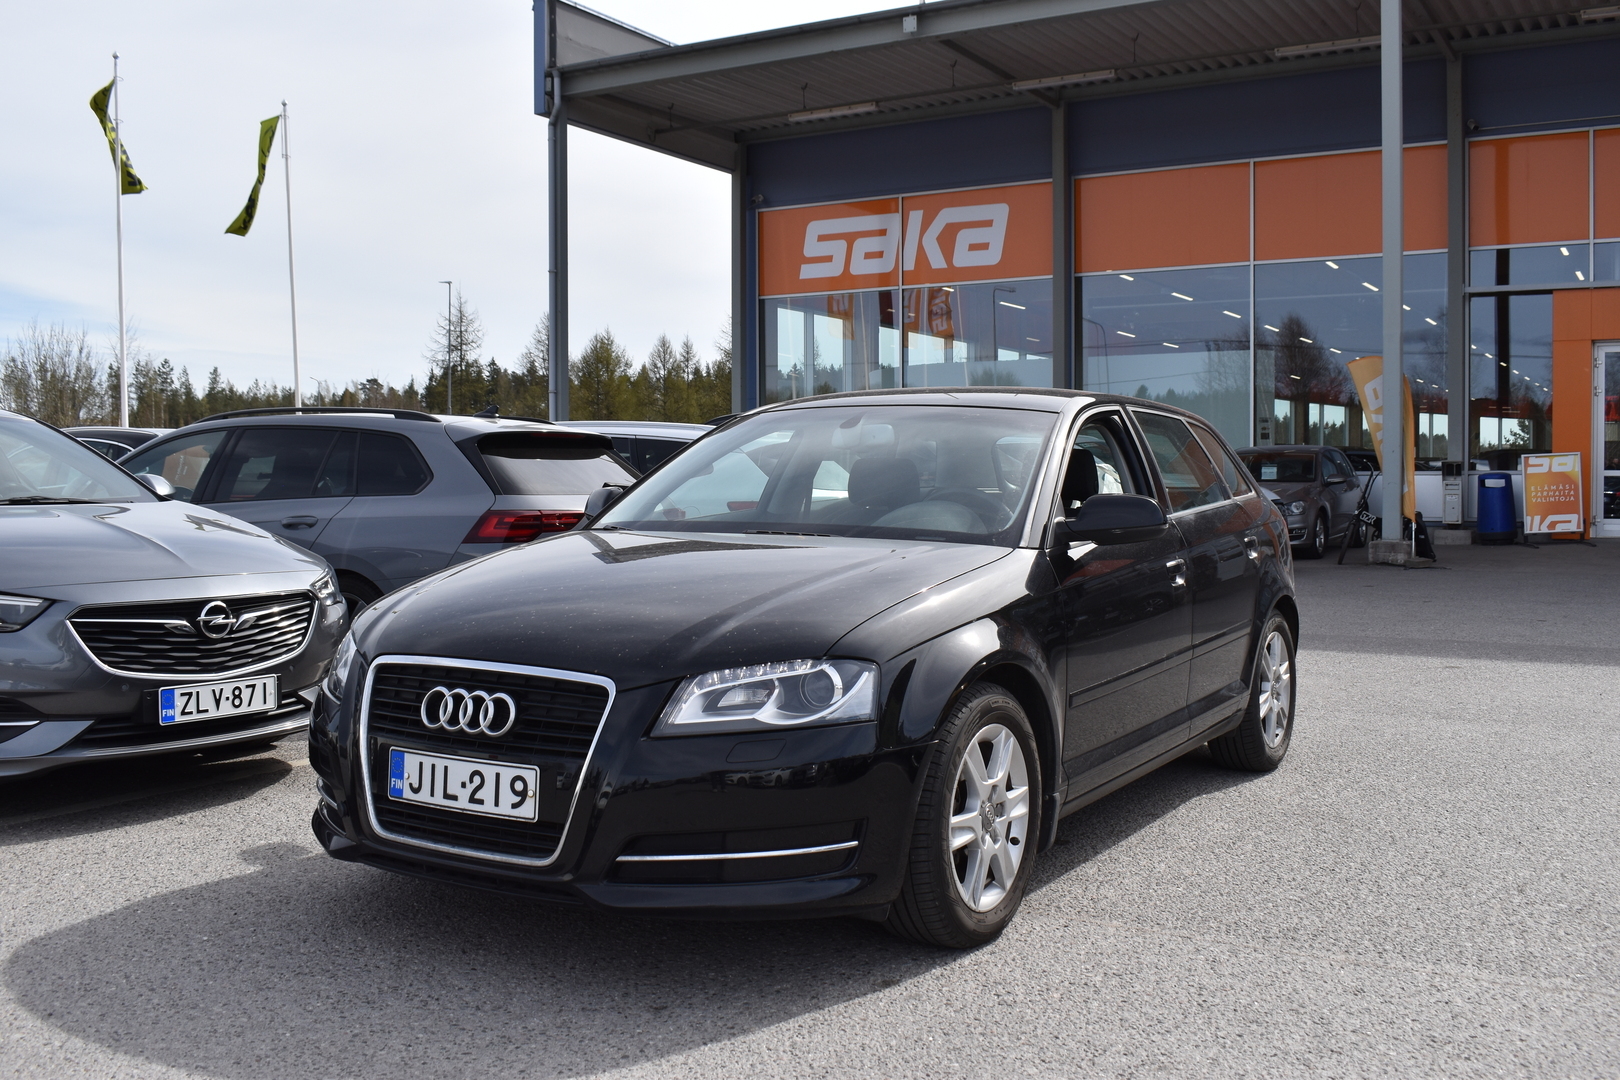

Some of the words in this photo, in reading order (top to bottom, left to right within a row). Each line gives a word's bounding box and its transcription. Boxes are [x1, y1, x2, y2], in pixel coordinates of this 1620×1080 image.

[180, 682, 266, 716] ZLV-871
[162, 708, 174, 717] FIN
[390, 778, 403, 790] FIN
[408, 761, 528, 810] JIL-219
